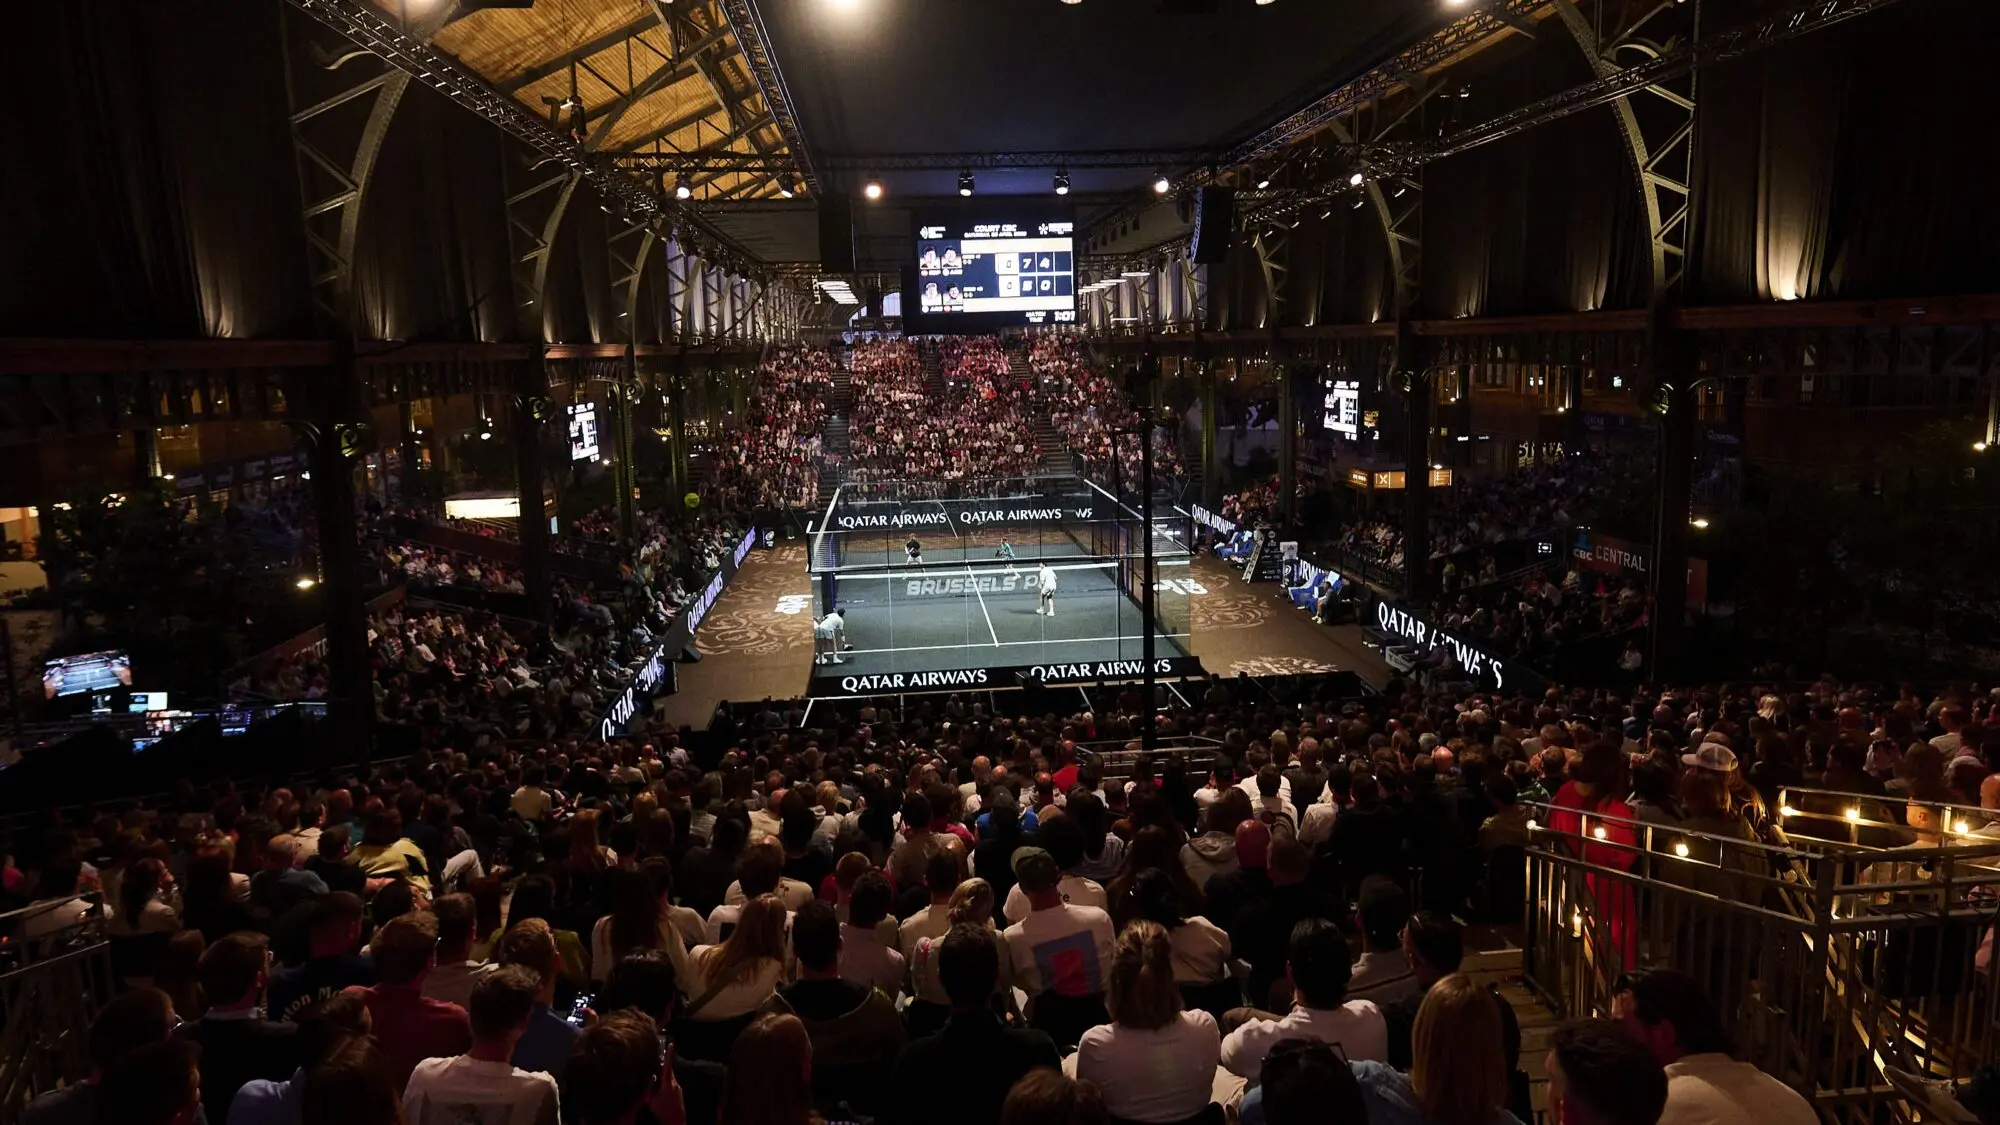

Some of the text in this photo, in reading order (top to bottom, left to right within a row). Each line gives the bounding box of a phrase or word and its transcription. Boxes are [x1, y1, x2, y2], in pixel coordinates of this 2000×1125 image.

[1022, 258, 1032, 269] 7
[1039, 257, 1050, 269] 4
[1040, 280, 1051, 291] 0
[843, 514, 888, 529] QATAR
[890, 511, 947, 528] AIRWAYS
[960, 508, 1062, 523] QATAR AIRWAYS
[1191, 503, 1211, 526] QATAR
[1595, 545, 1646, 573] CENTRAL
[906, 575, 1016, 596] BRUSSELS
[688, 595, 706, 635] QATAR
[1378, 601, 1503, 689] QATAR AWAS
[842, 668, 988, 693] QATAR AIRWAYS
[1030, 658, 1172, 682] QATAR AIRWYS
